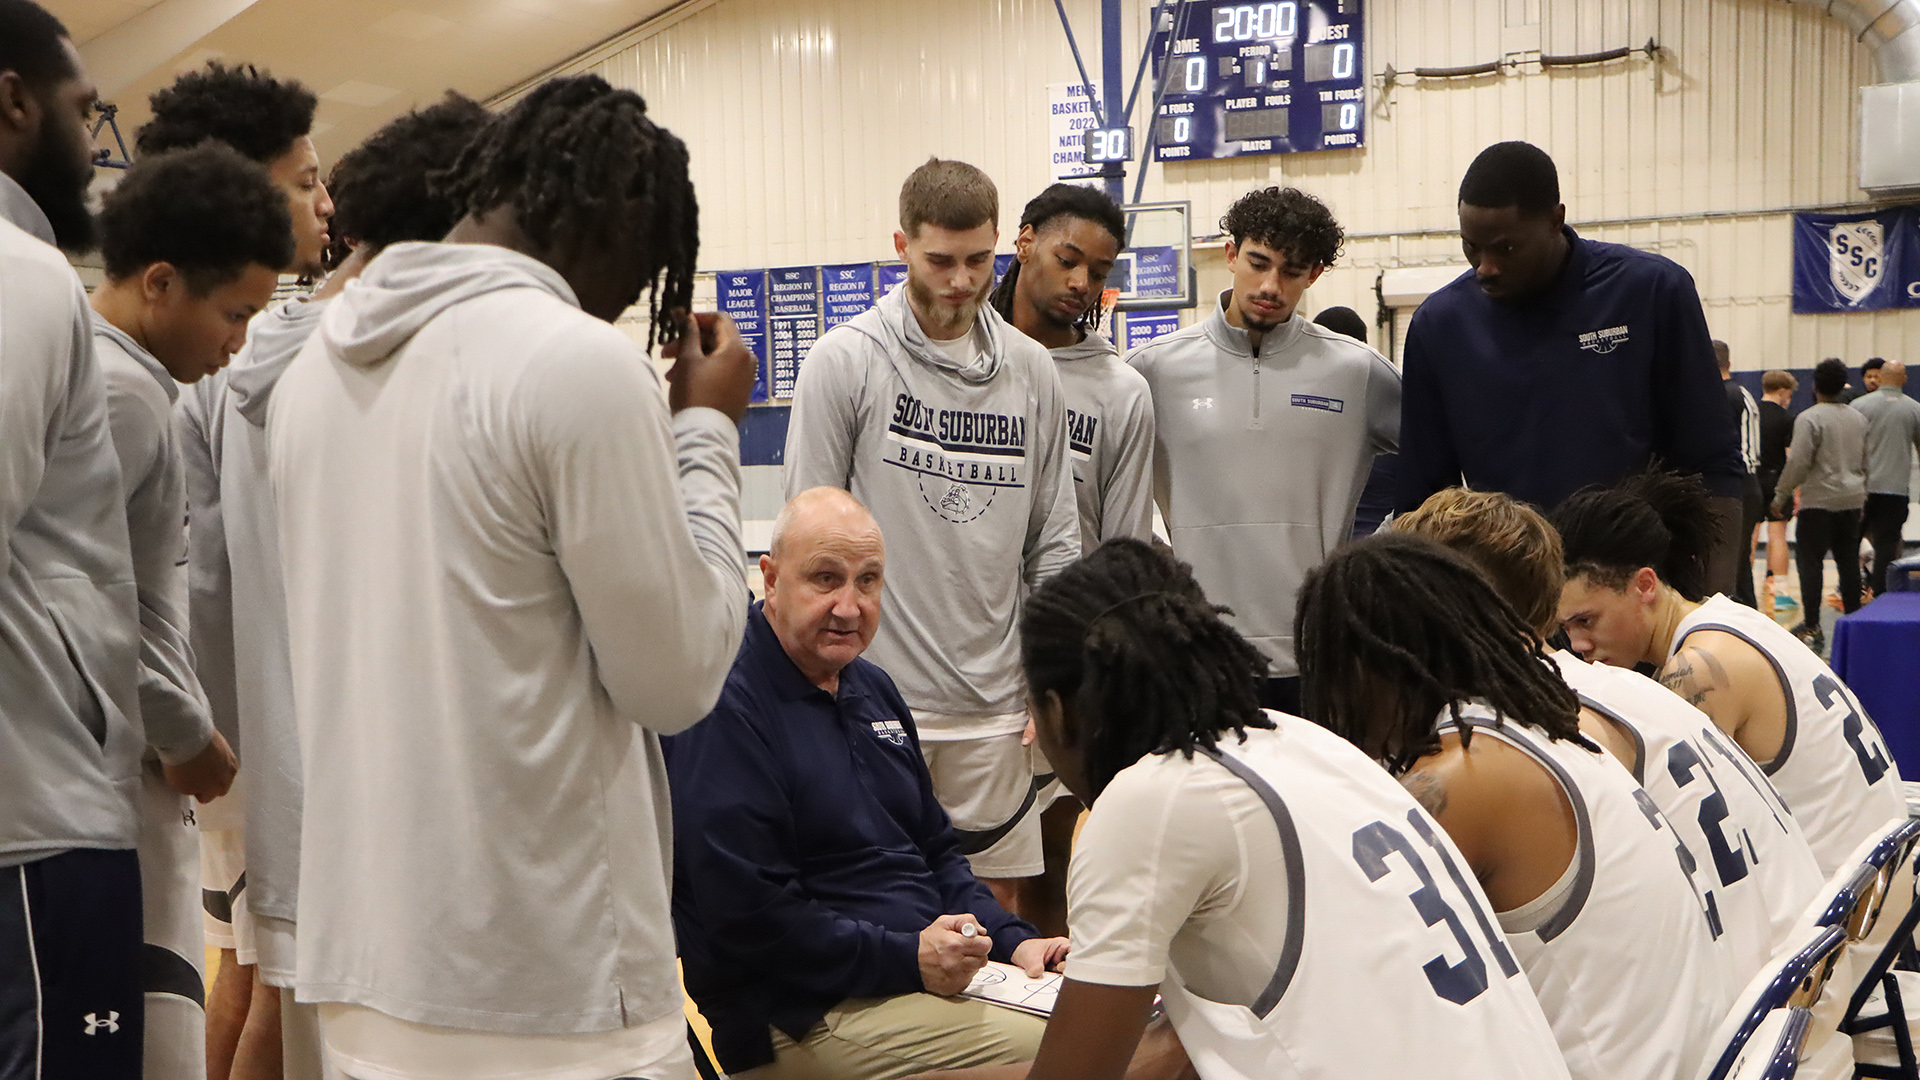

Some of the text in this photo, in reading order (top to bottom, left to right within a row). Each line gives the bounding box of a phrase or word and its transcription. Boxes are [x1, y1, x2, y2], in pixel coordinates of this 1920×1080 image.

[1215, 2, 1297, 42] 20:00
[1239, 45, 1271, 57] PERIOD
[1333, 44, 1354, 79] 0
[1186, 57, 1205, 91] 0
[1256, 61, 1264, 84] 1
[1319, 88, 1362, 102] TM FOULS
[1225, 94, 1292, 110] PLAYER FOULS
[1169, 102, 1195, 114] FOULS
[1340, 103, 1357, 130] 0
[1069, 117, 1095, 130] 2022
[1174, 117, 1190, 143] 0
[1091, 129, 1125, 161] 30
[1324, 133, 1357, 146] POINTS
[1241, 139, 1272, 152] MATCH
[1159, 145, 1191, 158] POINTS
[1142, 254, 1159, 263] SSC
[1835, 233, 1878, 279] SSC
[785, 272, 800, 280] SSC
[840, 270, 856, 280] SSC
[732, 276, 748, 286] SSC
[829, 281, 866, 291] REGION IV
[773, 282, 813, 292] REGION IV
[728, 288, 754, 298] MAJOR
[770, 293, 816, 303] CHAMPIONS
[826, 292, 870, 303] CHAMPIONS
[726, 299, 756, 309] LEAGUE
[774, 304, 813, 314] BASEBALL
[774, 320, 816, 330] 1991 2002
[1130, 325, 1152, 335] 2000
[797, 330, 817, 339] 2005
[775, 360, 794, 369] 2012
[775, 370, 795, 379] 2014
[775, 380, 794, 389] 2021
[1351, 807, 1521, 1007] 31
